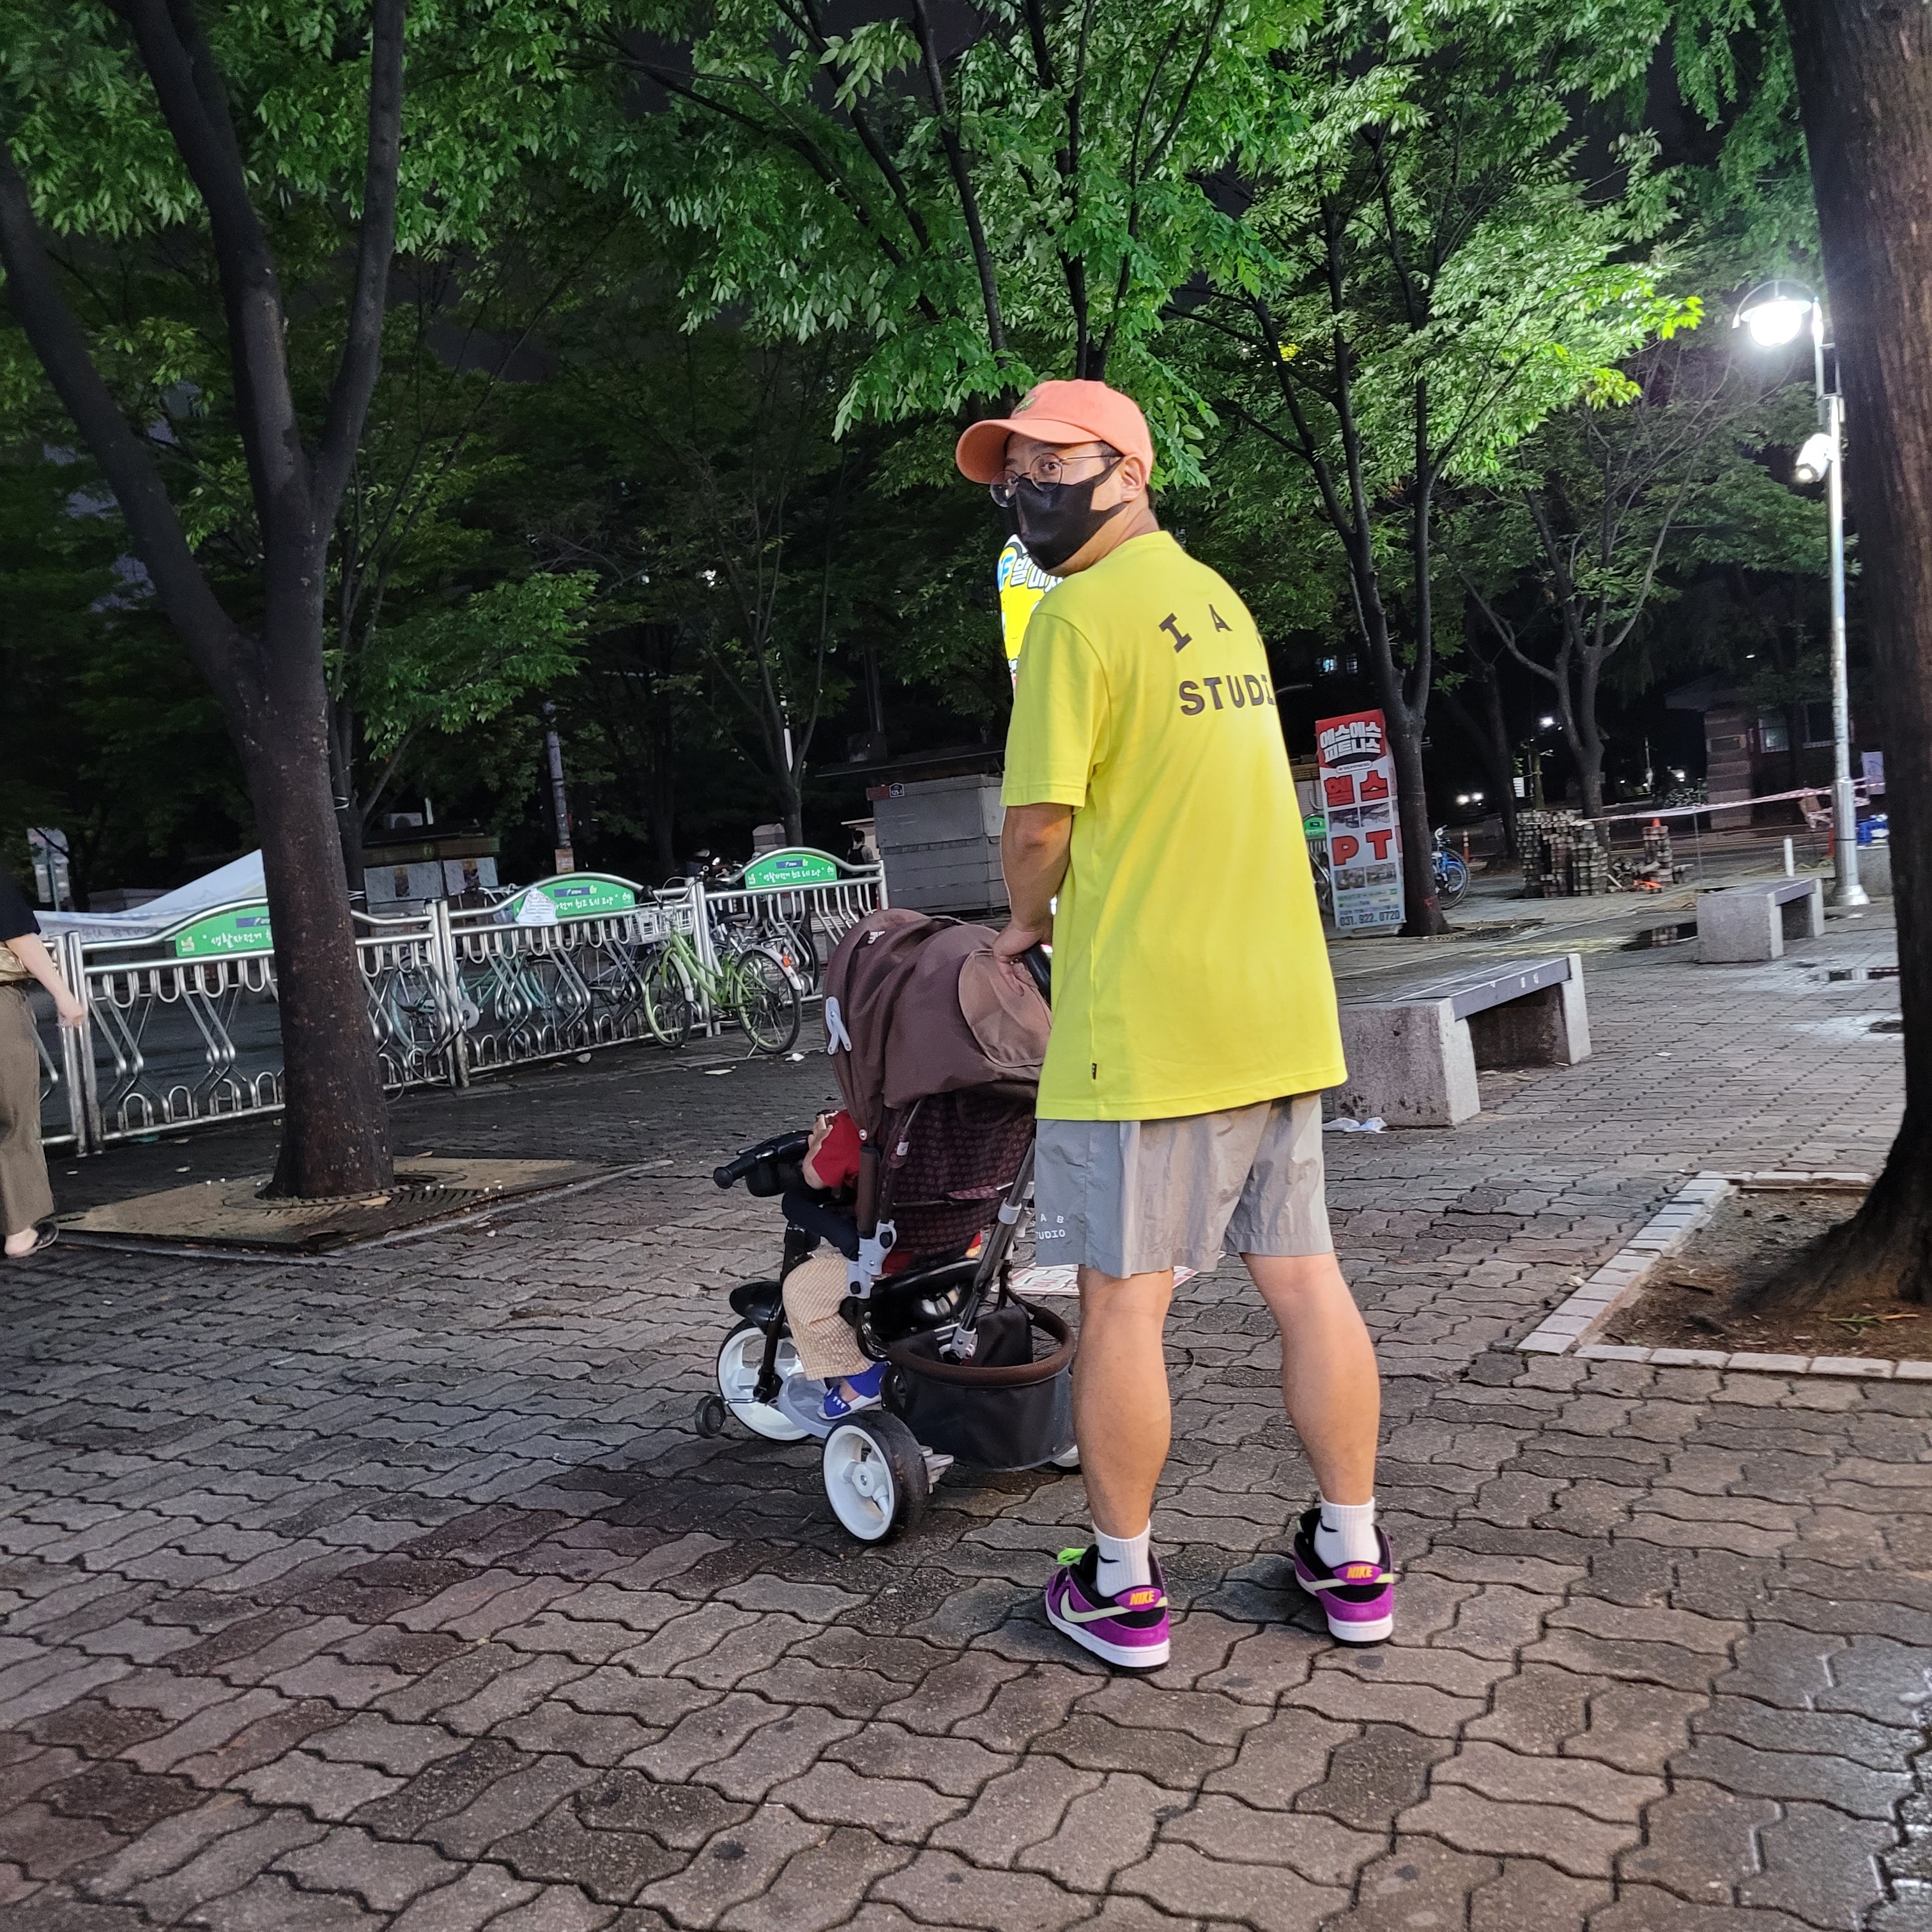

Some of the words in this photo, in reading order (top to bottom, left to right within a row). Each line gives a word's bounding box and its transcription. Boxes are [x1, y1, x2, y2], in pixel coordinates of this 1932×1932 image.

[1320, 721, 1382, 748] 에스에스
[1324, 738, 1381, 763] 피트니스
[1324, 770, 1389, 808] 헬스
[1331, 829, 1393, 866] PT
[1346, 1565, 1373, 1579] NIKE
[1130, 1590, 1155, 1606] NIKE
